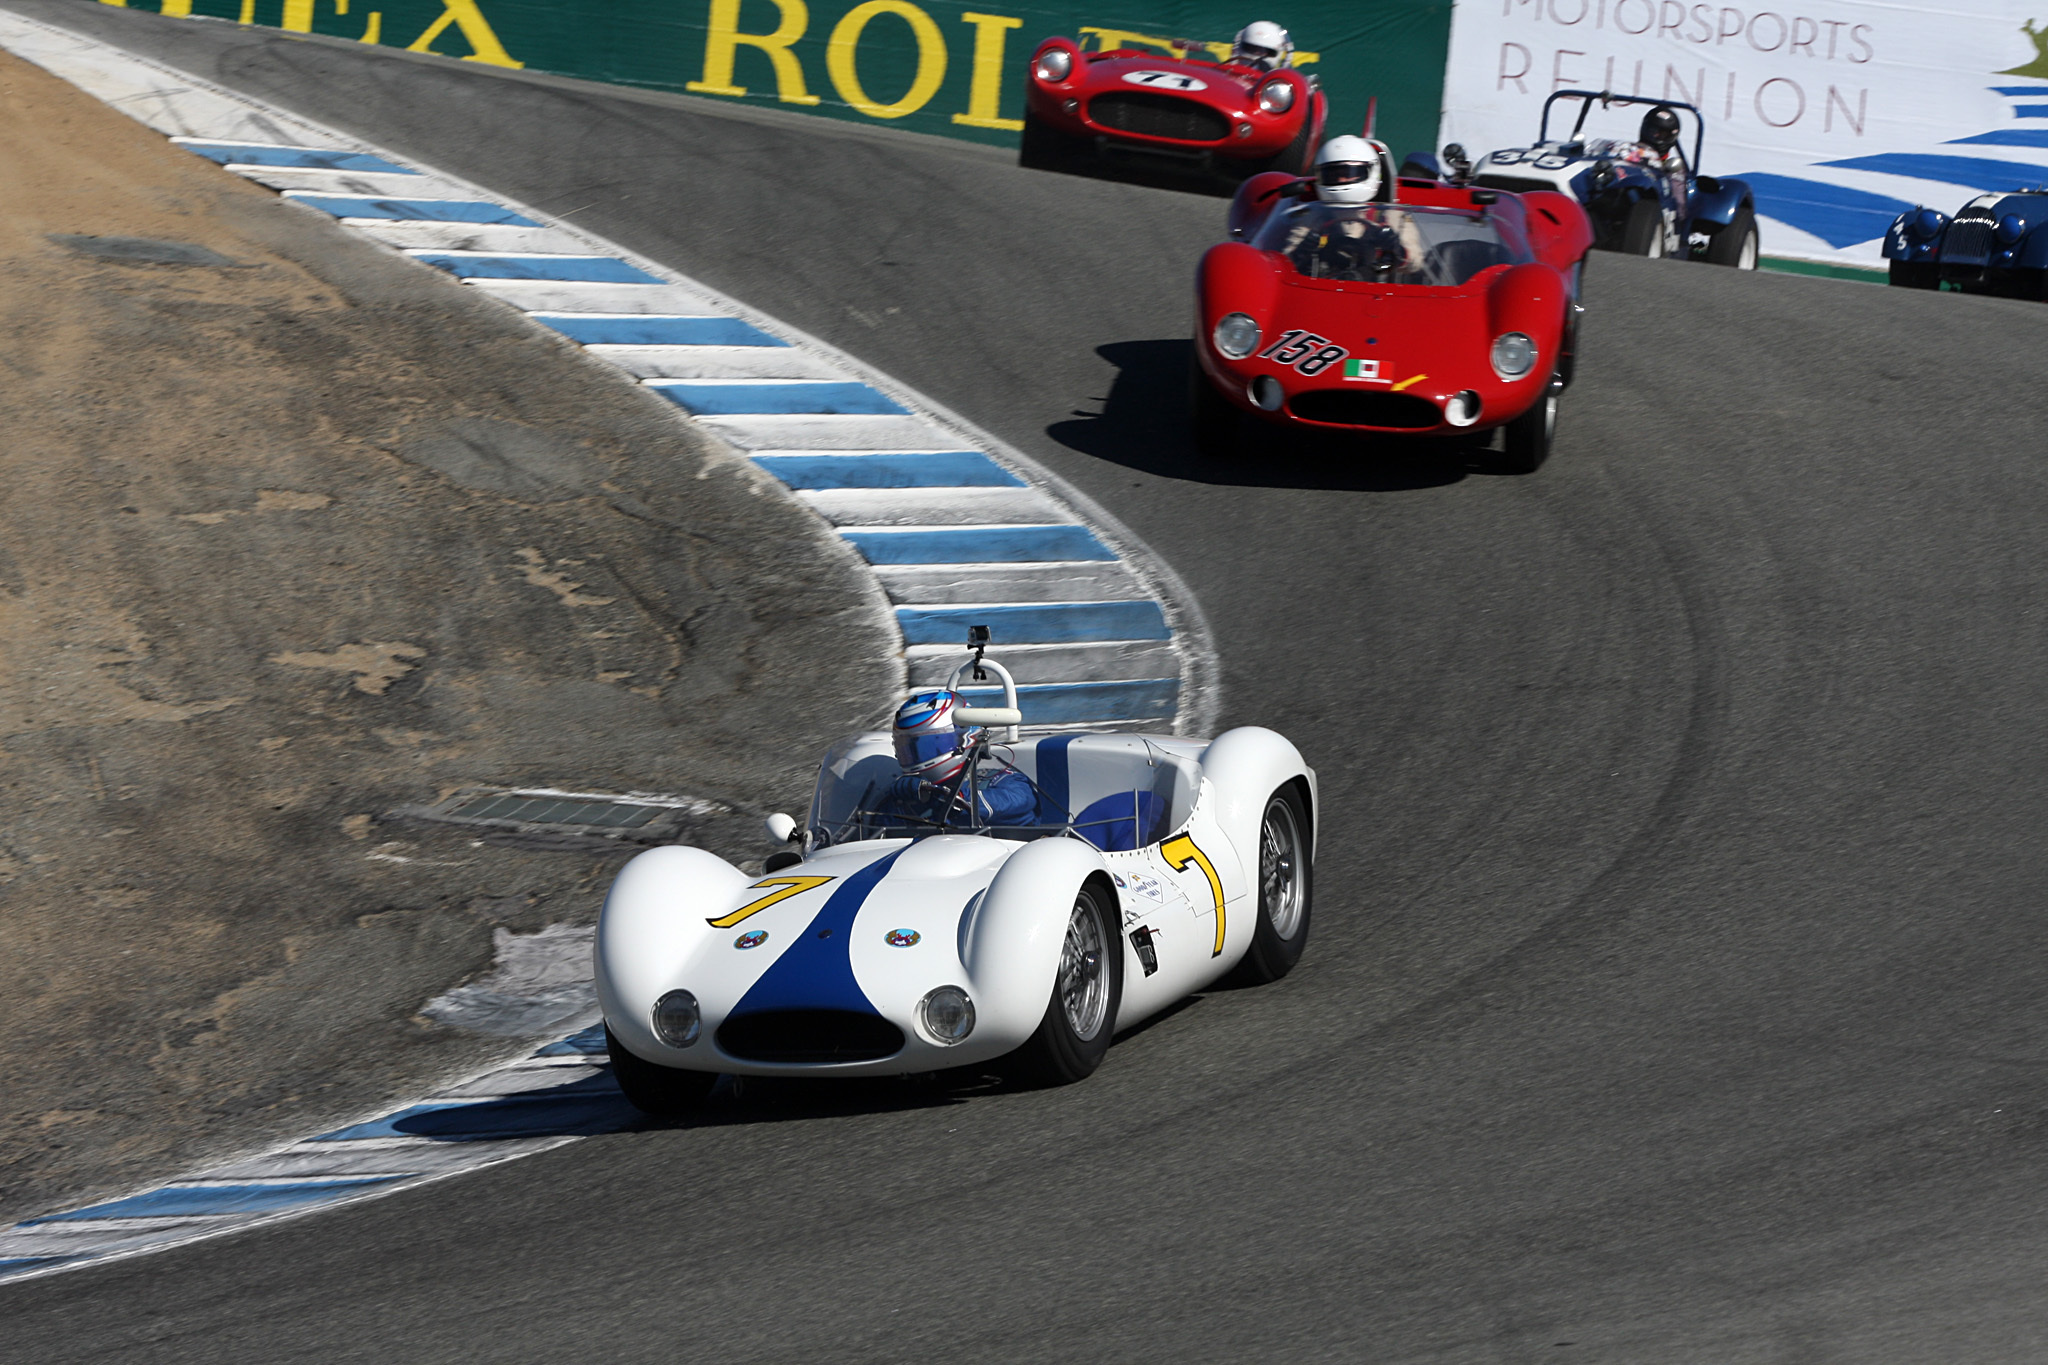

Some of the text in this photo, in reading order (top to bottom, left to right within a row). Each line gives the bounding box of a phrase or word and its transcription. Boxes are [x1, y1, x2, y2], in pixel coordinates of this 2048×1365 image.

[1137, 71, 1195, 89] 71
[1497, 42, 1868, 137] REUNION
[1256, 329, 1350, 376] 158
[705, 876, 838, 928] 7
[1160, 831, 1226, 959] 7
